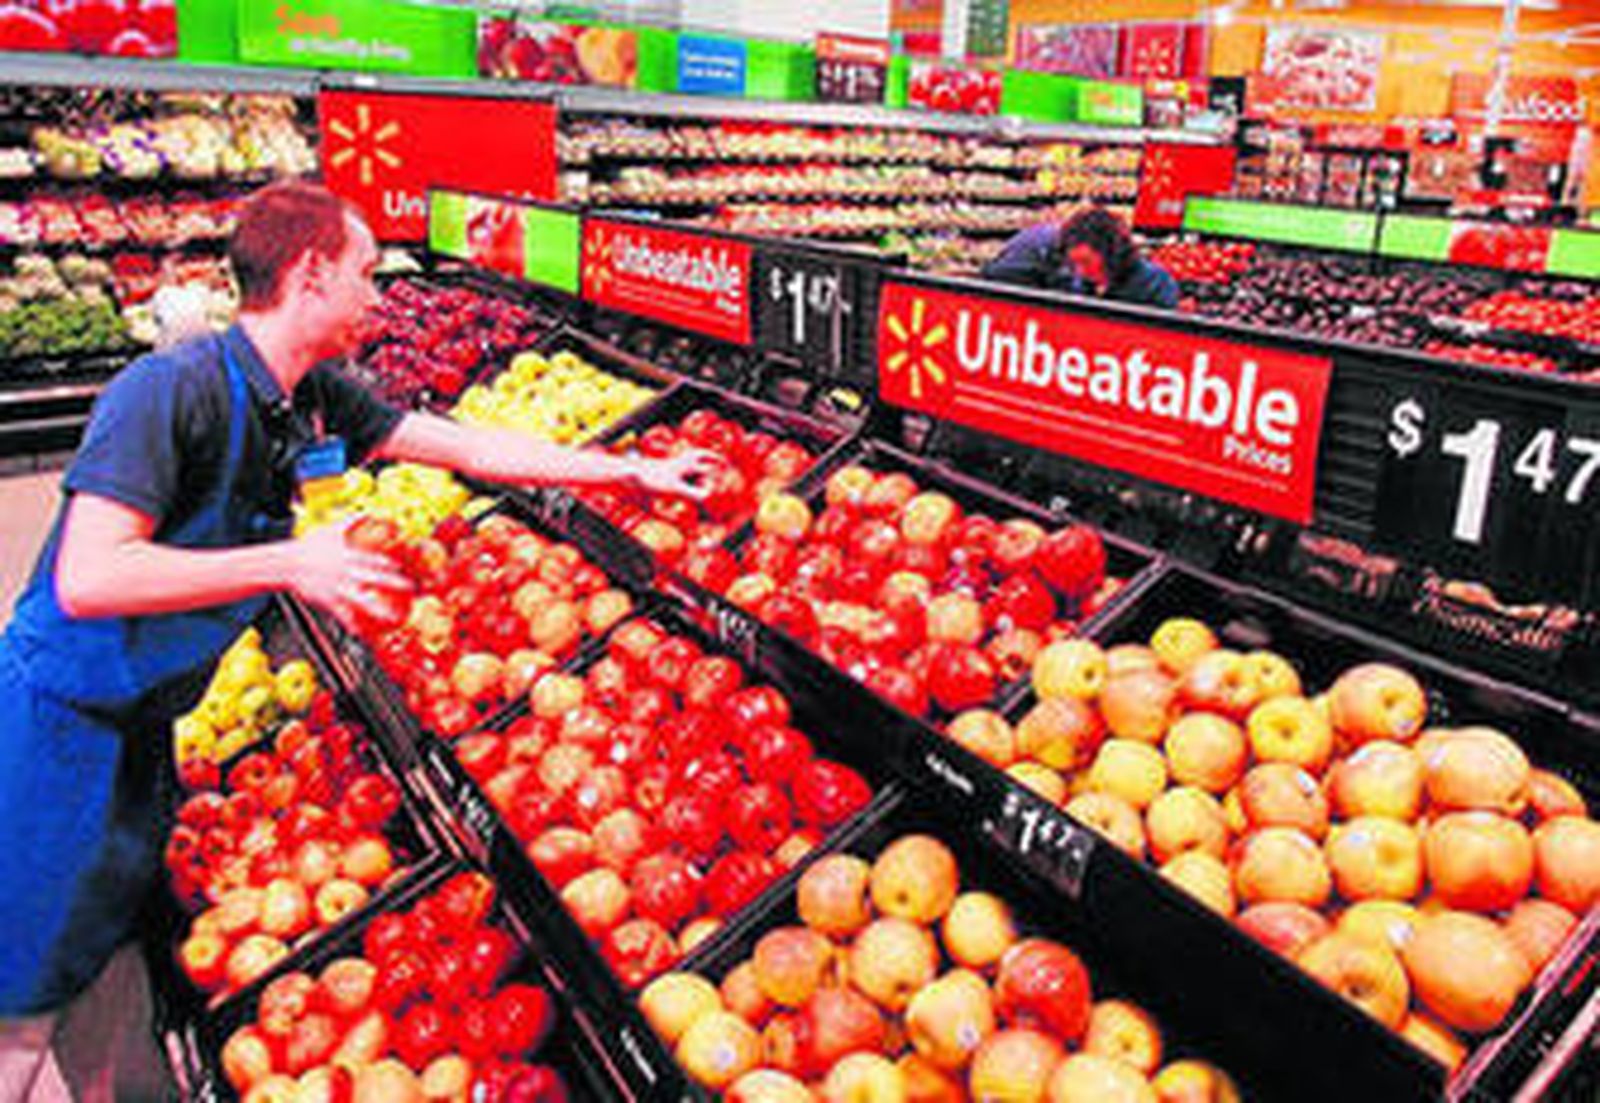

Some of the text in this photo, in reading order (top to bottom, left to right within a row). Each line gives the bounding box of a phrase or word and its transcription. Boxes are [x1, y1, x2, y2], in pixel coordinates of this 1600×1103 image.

[612, 232, 741, 298] Unbeatable
[955, 309, 1299, 445] Unbeatable
[1223, 436, 1293, 475] Prices
